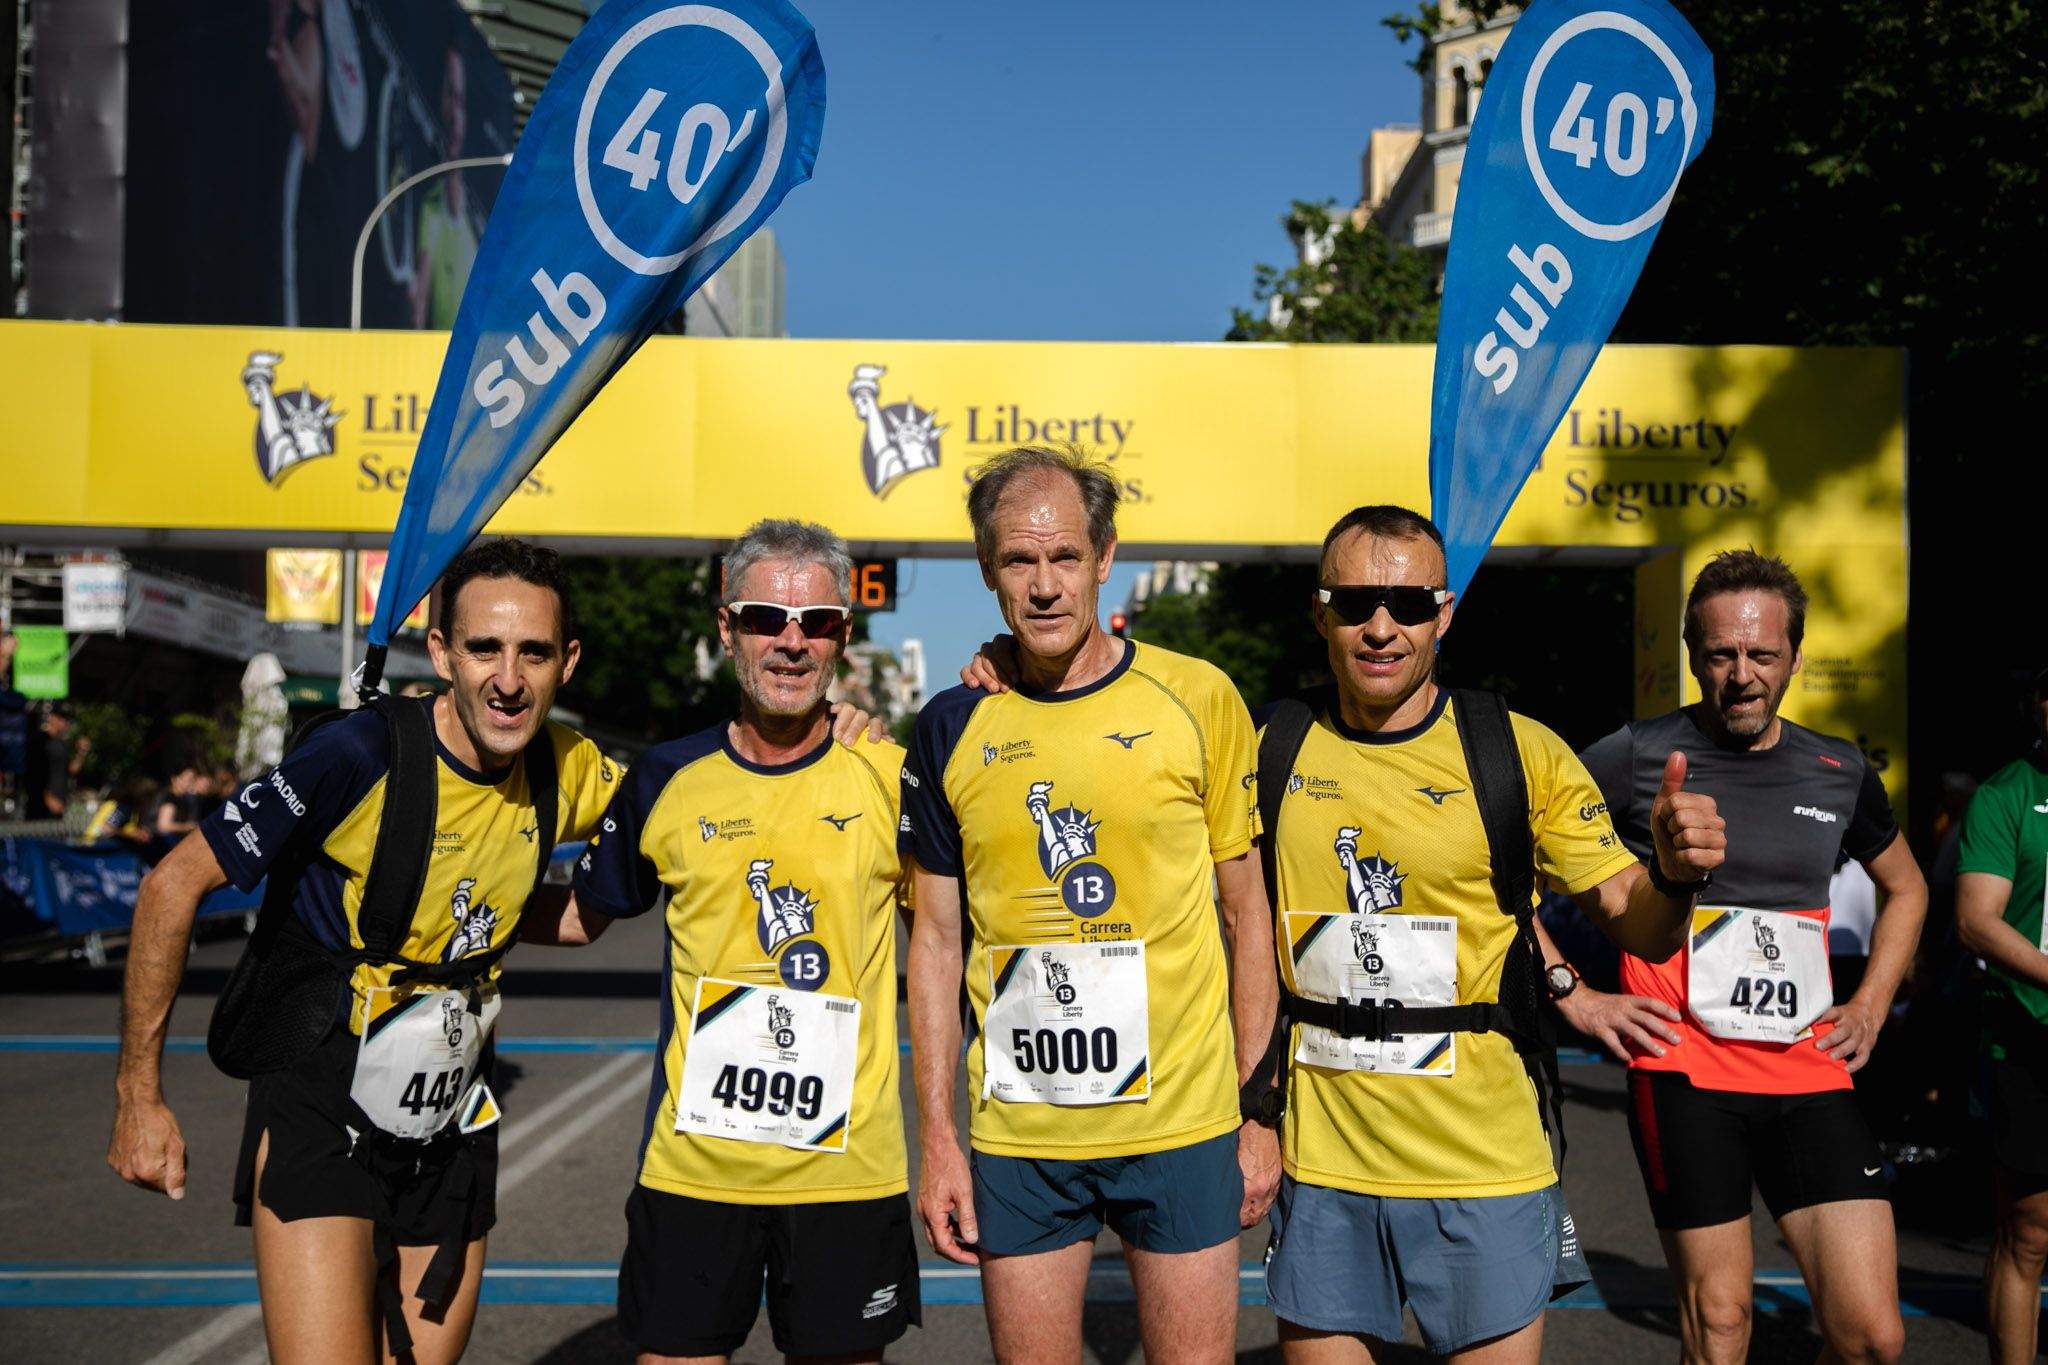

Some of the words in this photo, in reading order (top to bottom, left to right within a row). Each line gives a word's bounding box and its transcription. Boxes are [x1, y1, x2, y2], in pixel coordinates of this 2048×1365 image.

[1474, 243, 1573, 394] sub
[474, 268, 606, 429] sub
[966, 404, 1134, 461] Liberty
[1569, 409, 1738, 466] Liberty
[1001, 740, 1032, 752] Liberty
[271, 770, 307, 817] MADRID
[1306, 788, 1344, 801] Seguros.
[1307, 776, 1339, 791] Liberty
[720, 818, 752, 829] Liberty
[1073, 876, 1105, 904] 13
[1080, 921, 1132, 934] Carrera
[789, 952, 821, 980] 13
[1366, 957, 1380, 970] 13
[1765, 946, 1777, 958] 13
[1058, 988, 1073, 1001] 13
[1730, 976, 1798, 1019] 429
[778, 1031, 793, 1046] 13
[1012, 1026, 1118, 1075] 5000
[398, 1066, 464, 1116] 443
[711, 1063, 824, 1122] 4999
